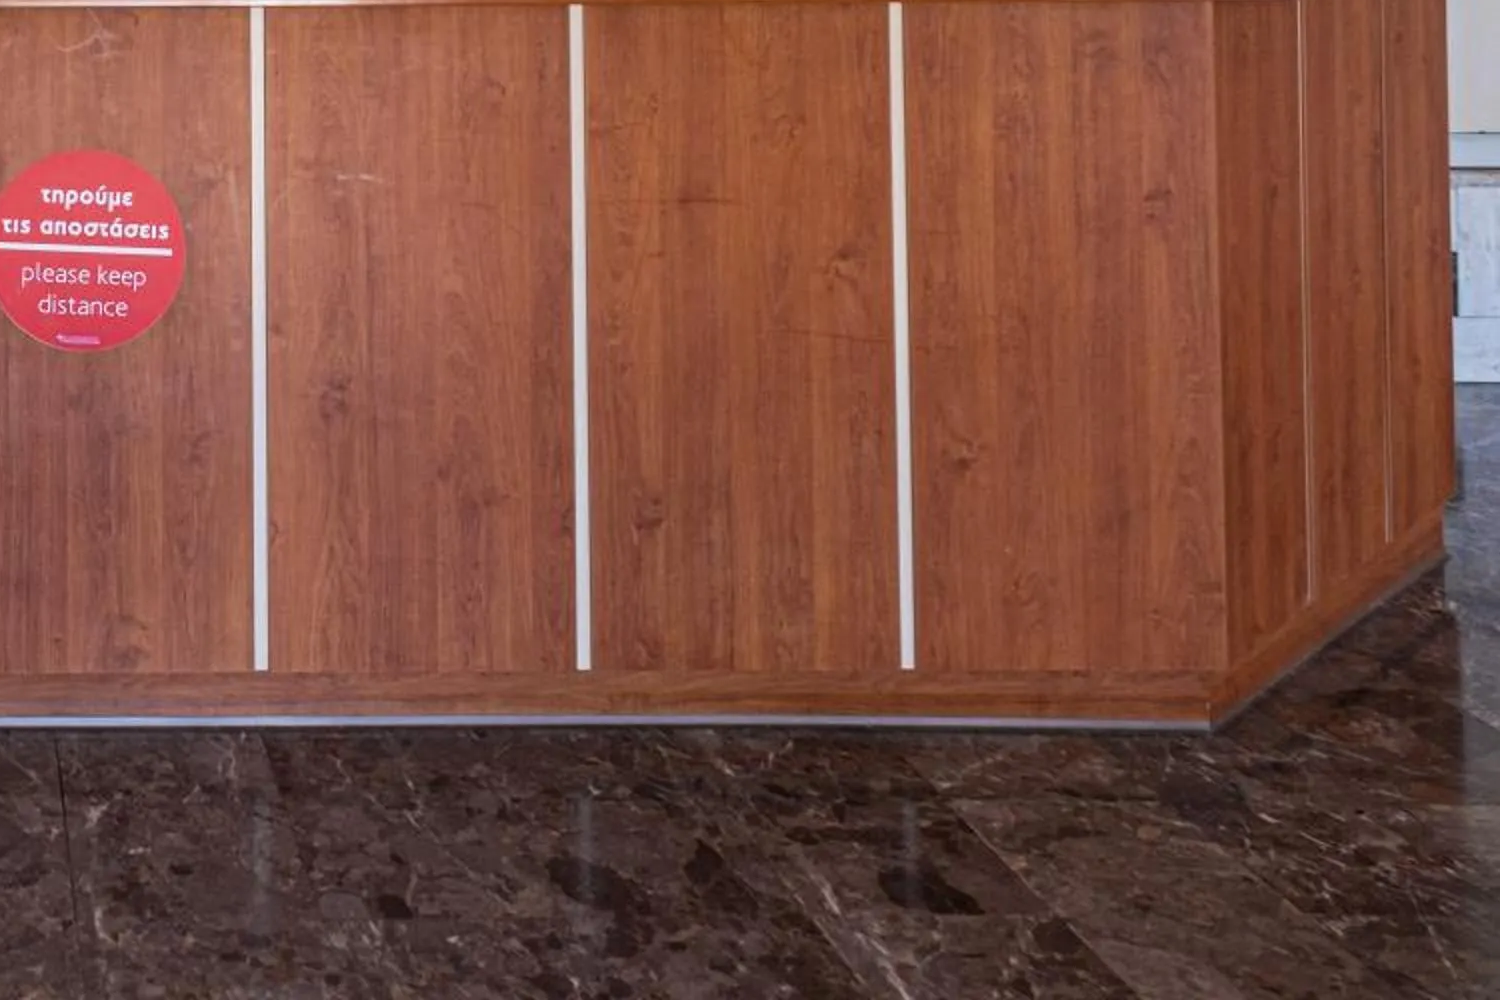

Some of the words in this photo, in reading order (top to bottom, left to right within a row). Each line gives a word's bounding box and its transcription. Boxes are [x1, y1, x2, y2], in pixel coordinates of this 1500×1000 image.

[40, 184, 133, 212] τηρούμε
[2, 218, 32, 234] τις
[40, 217, 170, 240] αποστάσεις
[21, 262, 91, 290] please
[97, 265, 148, 292] keep
[37, 294, 129, 318] distance
